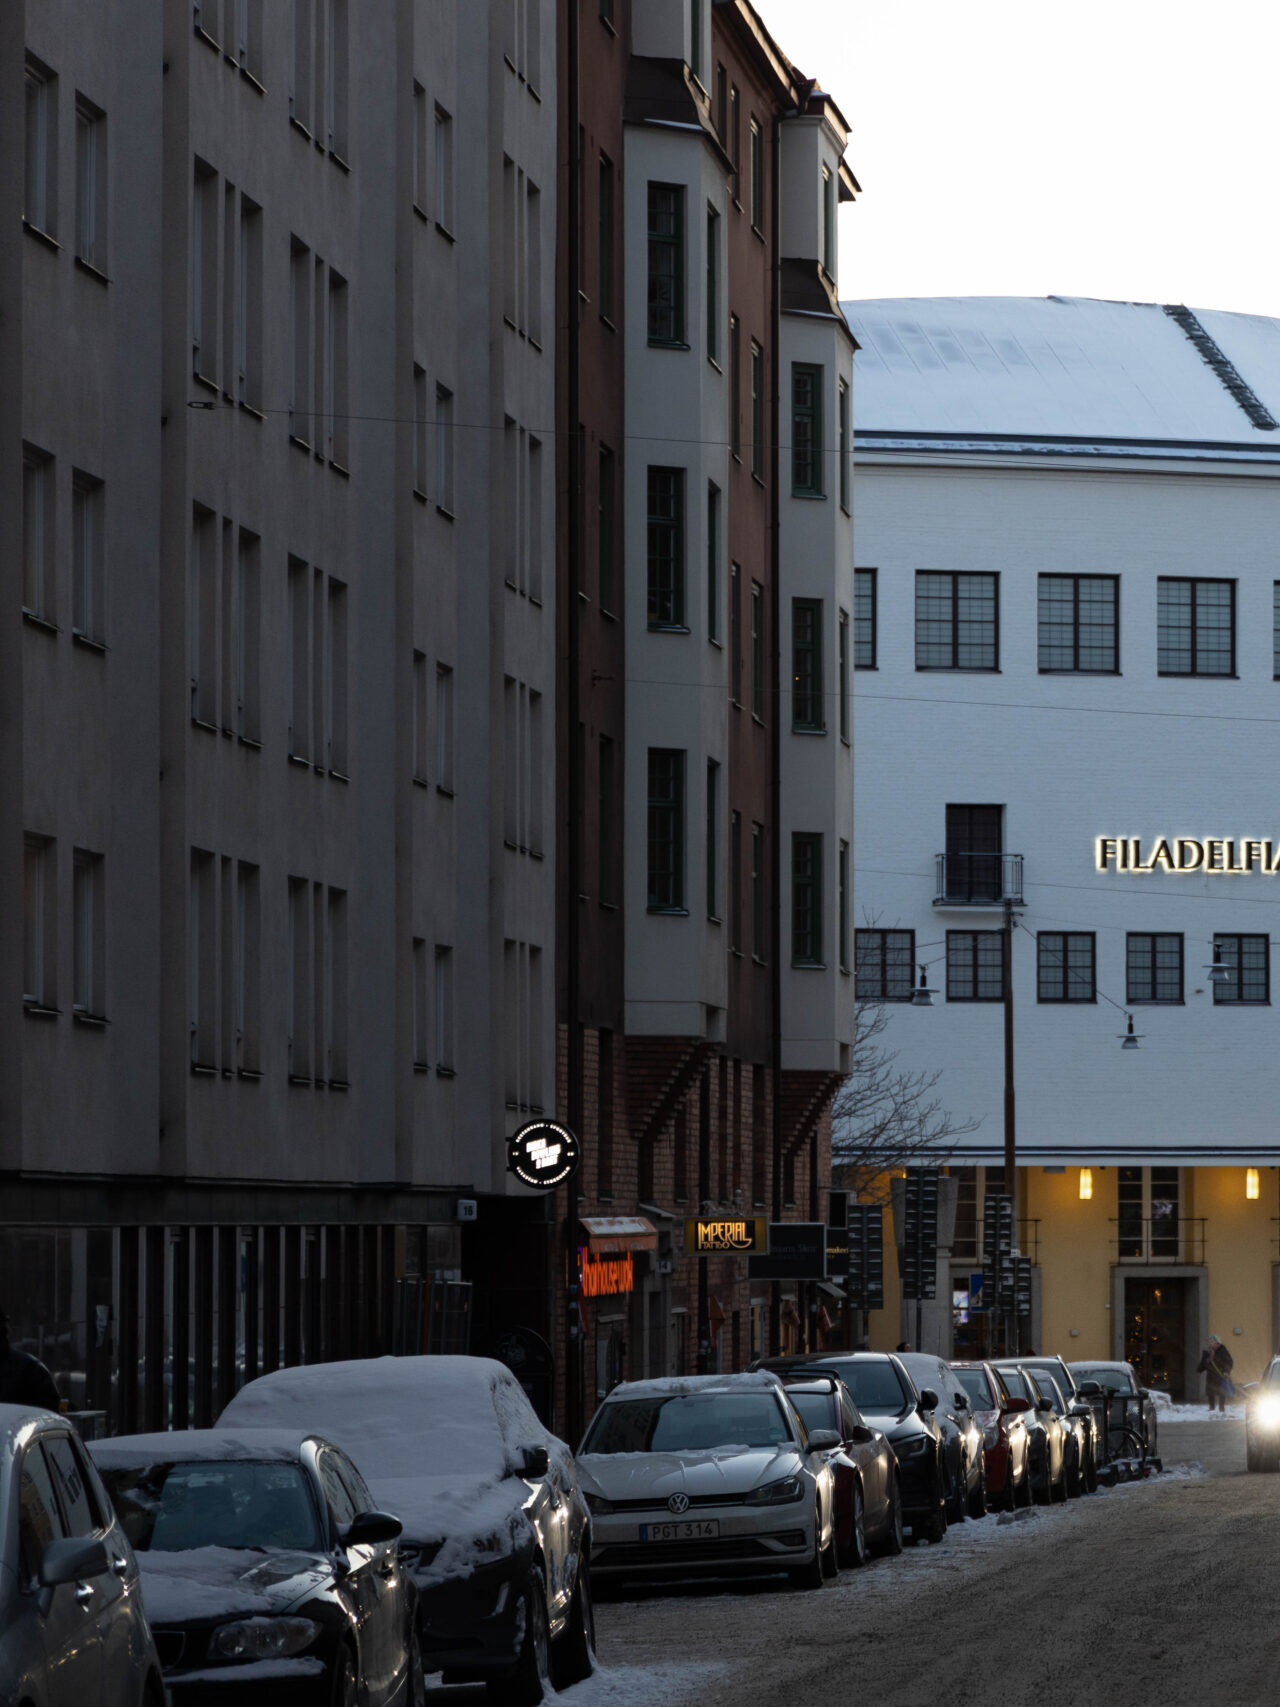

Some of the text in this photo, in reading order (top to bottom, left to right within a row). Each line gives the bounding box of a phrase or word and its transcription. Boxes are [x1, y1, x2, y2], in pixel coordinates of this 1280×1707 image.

[697, 1221, 753, 1250] IMPERIAL
[652, 1522, 713, 1539] PGT 314
